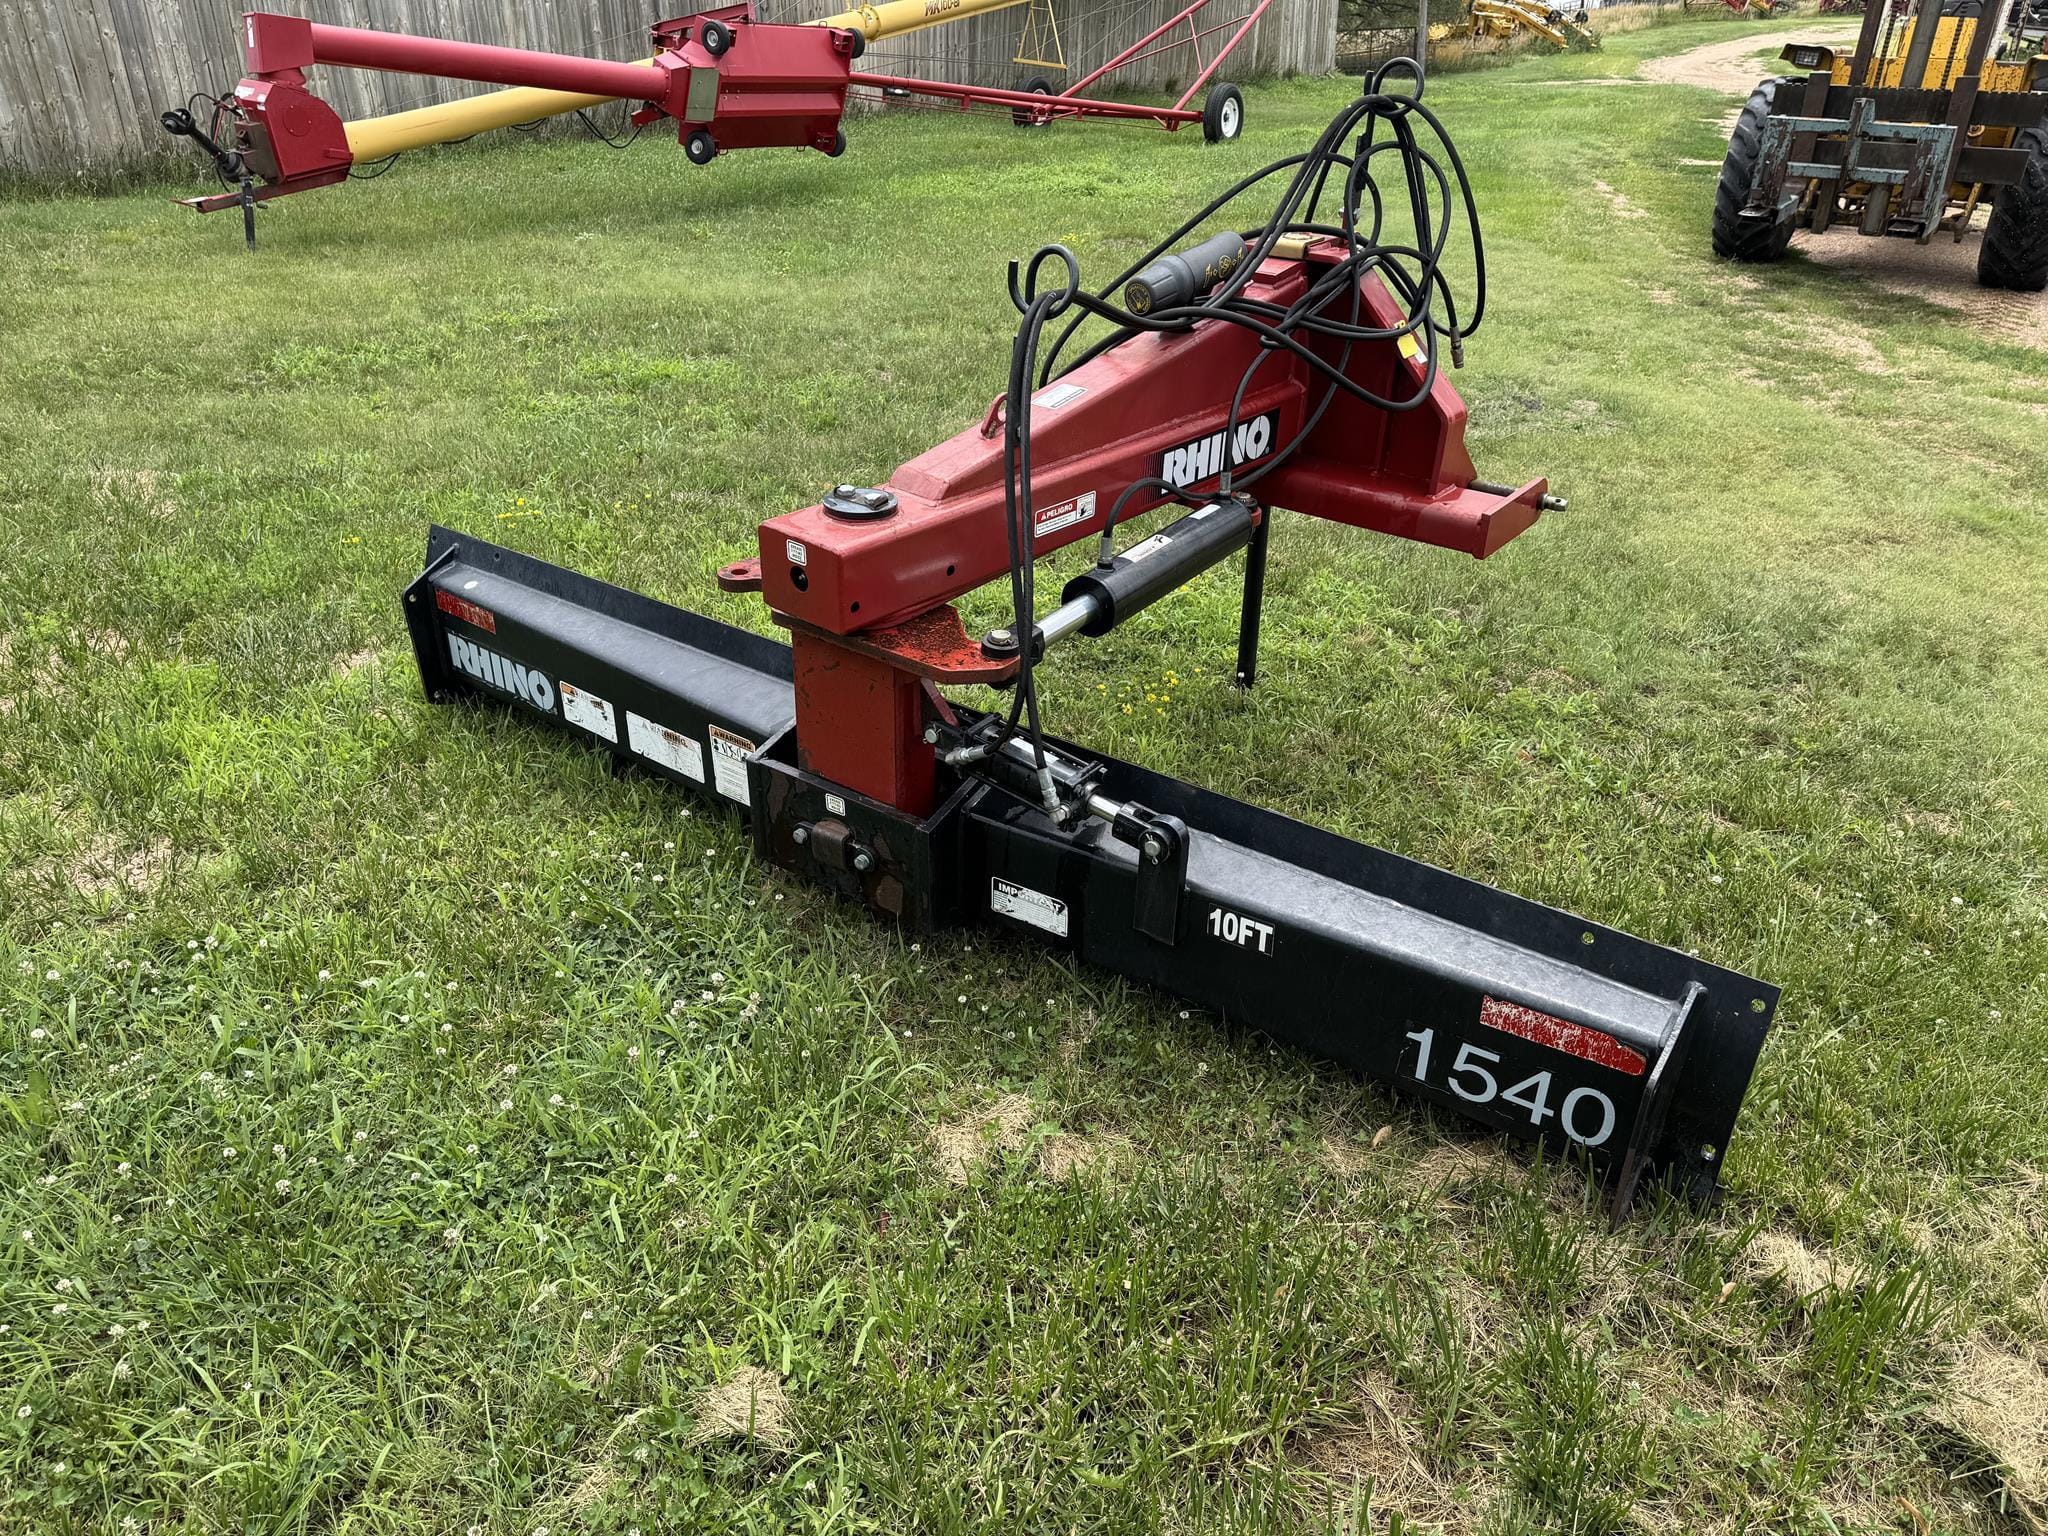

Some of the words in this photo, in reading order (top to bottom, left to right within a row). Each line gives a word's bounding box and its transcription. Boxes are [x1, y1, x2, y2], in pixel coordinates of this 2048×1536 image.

[1161, 415, 1271, 494] RHINO
[1046, 503, 1073, 519] PELIGRO
[447, 632, 555, 711] RHINO
[719, 730, 752, 750] WARNING
[1209, 907, 1274, 953] 10FT
[1405, 1027, 1616, 1147] 1540
